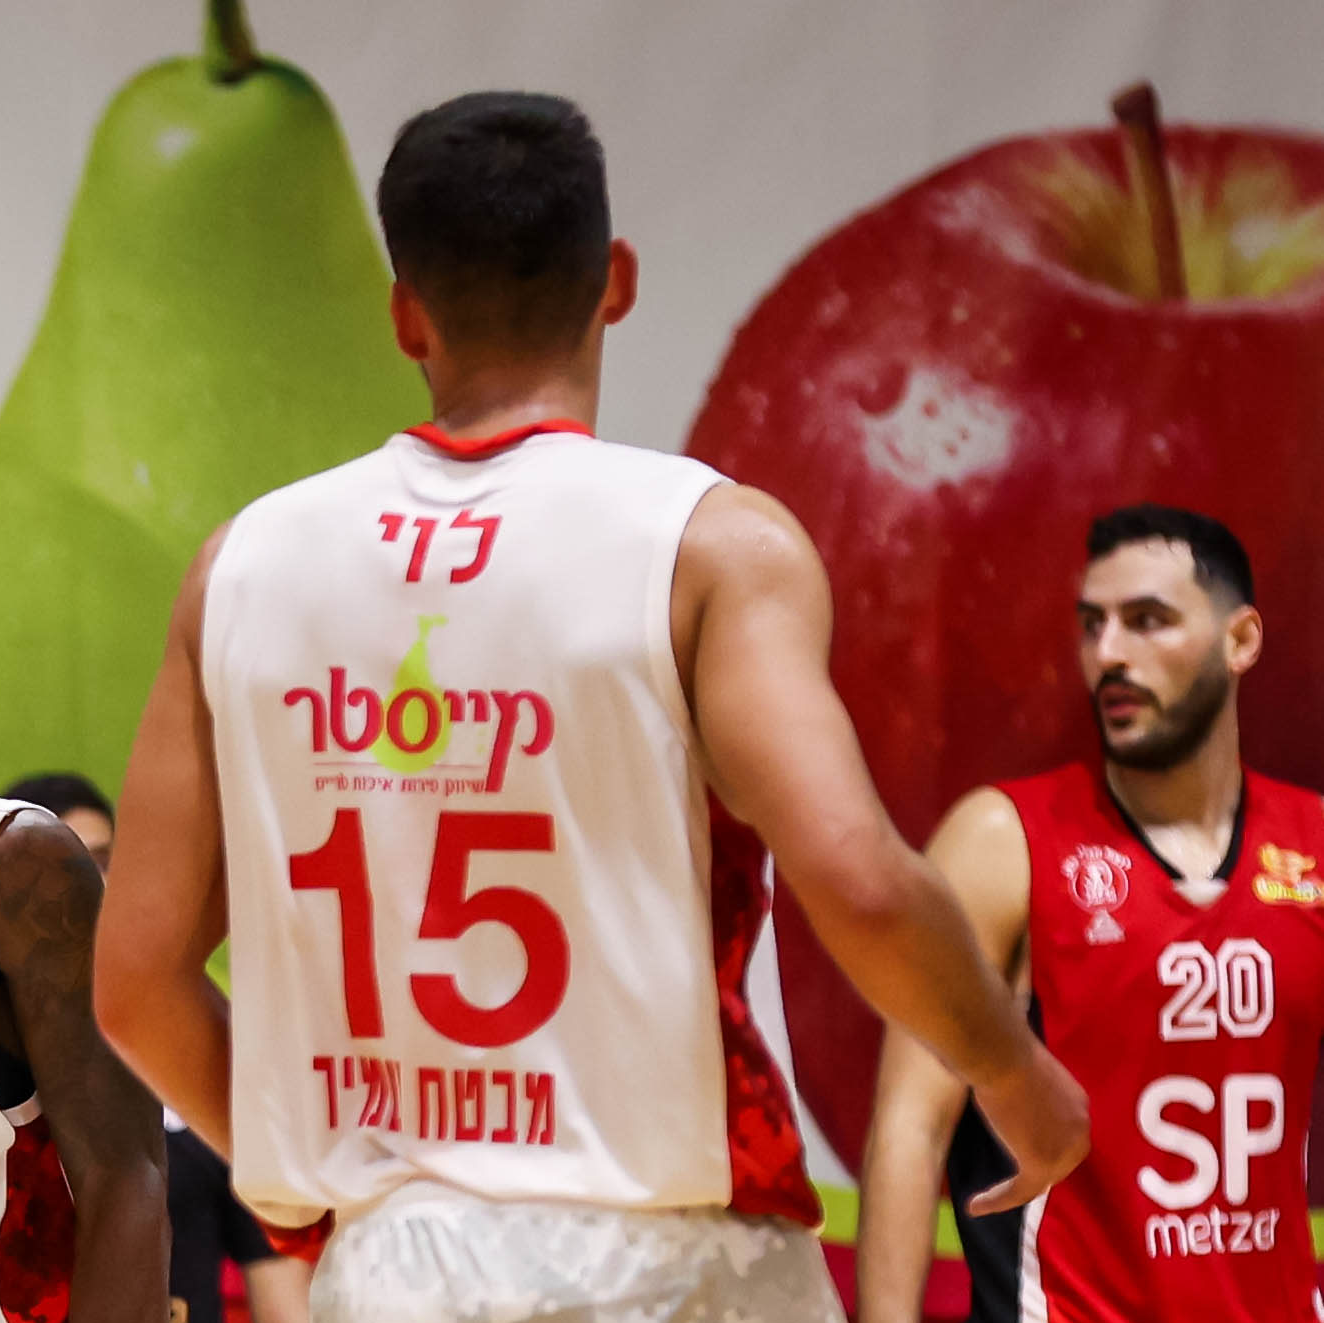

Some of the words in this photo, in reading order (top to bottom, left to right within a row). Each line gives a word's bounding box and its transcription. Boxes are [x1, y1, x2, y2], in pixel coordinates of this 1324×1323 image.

[377, 507, 503, 584] לוי
[283, 666, 555, 793] מייסטר
[289, 806, 572, 1049] 15
[1157, 938, 1275, 1042] 20
[416, 1064, 556, 1146] מבטח
[1136, 1072, 1285, 1209] SP
